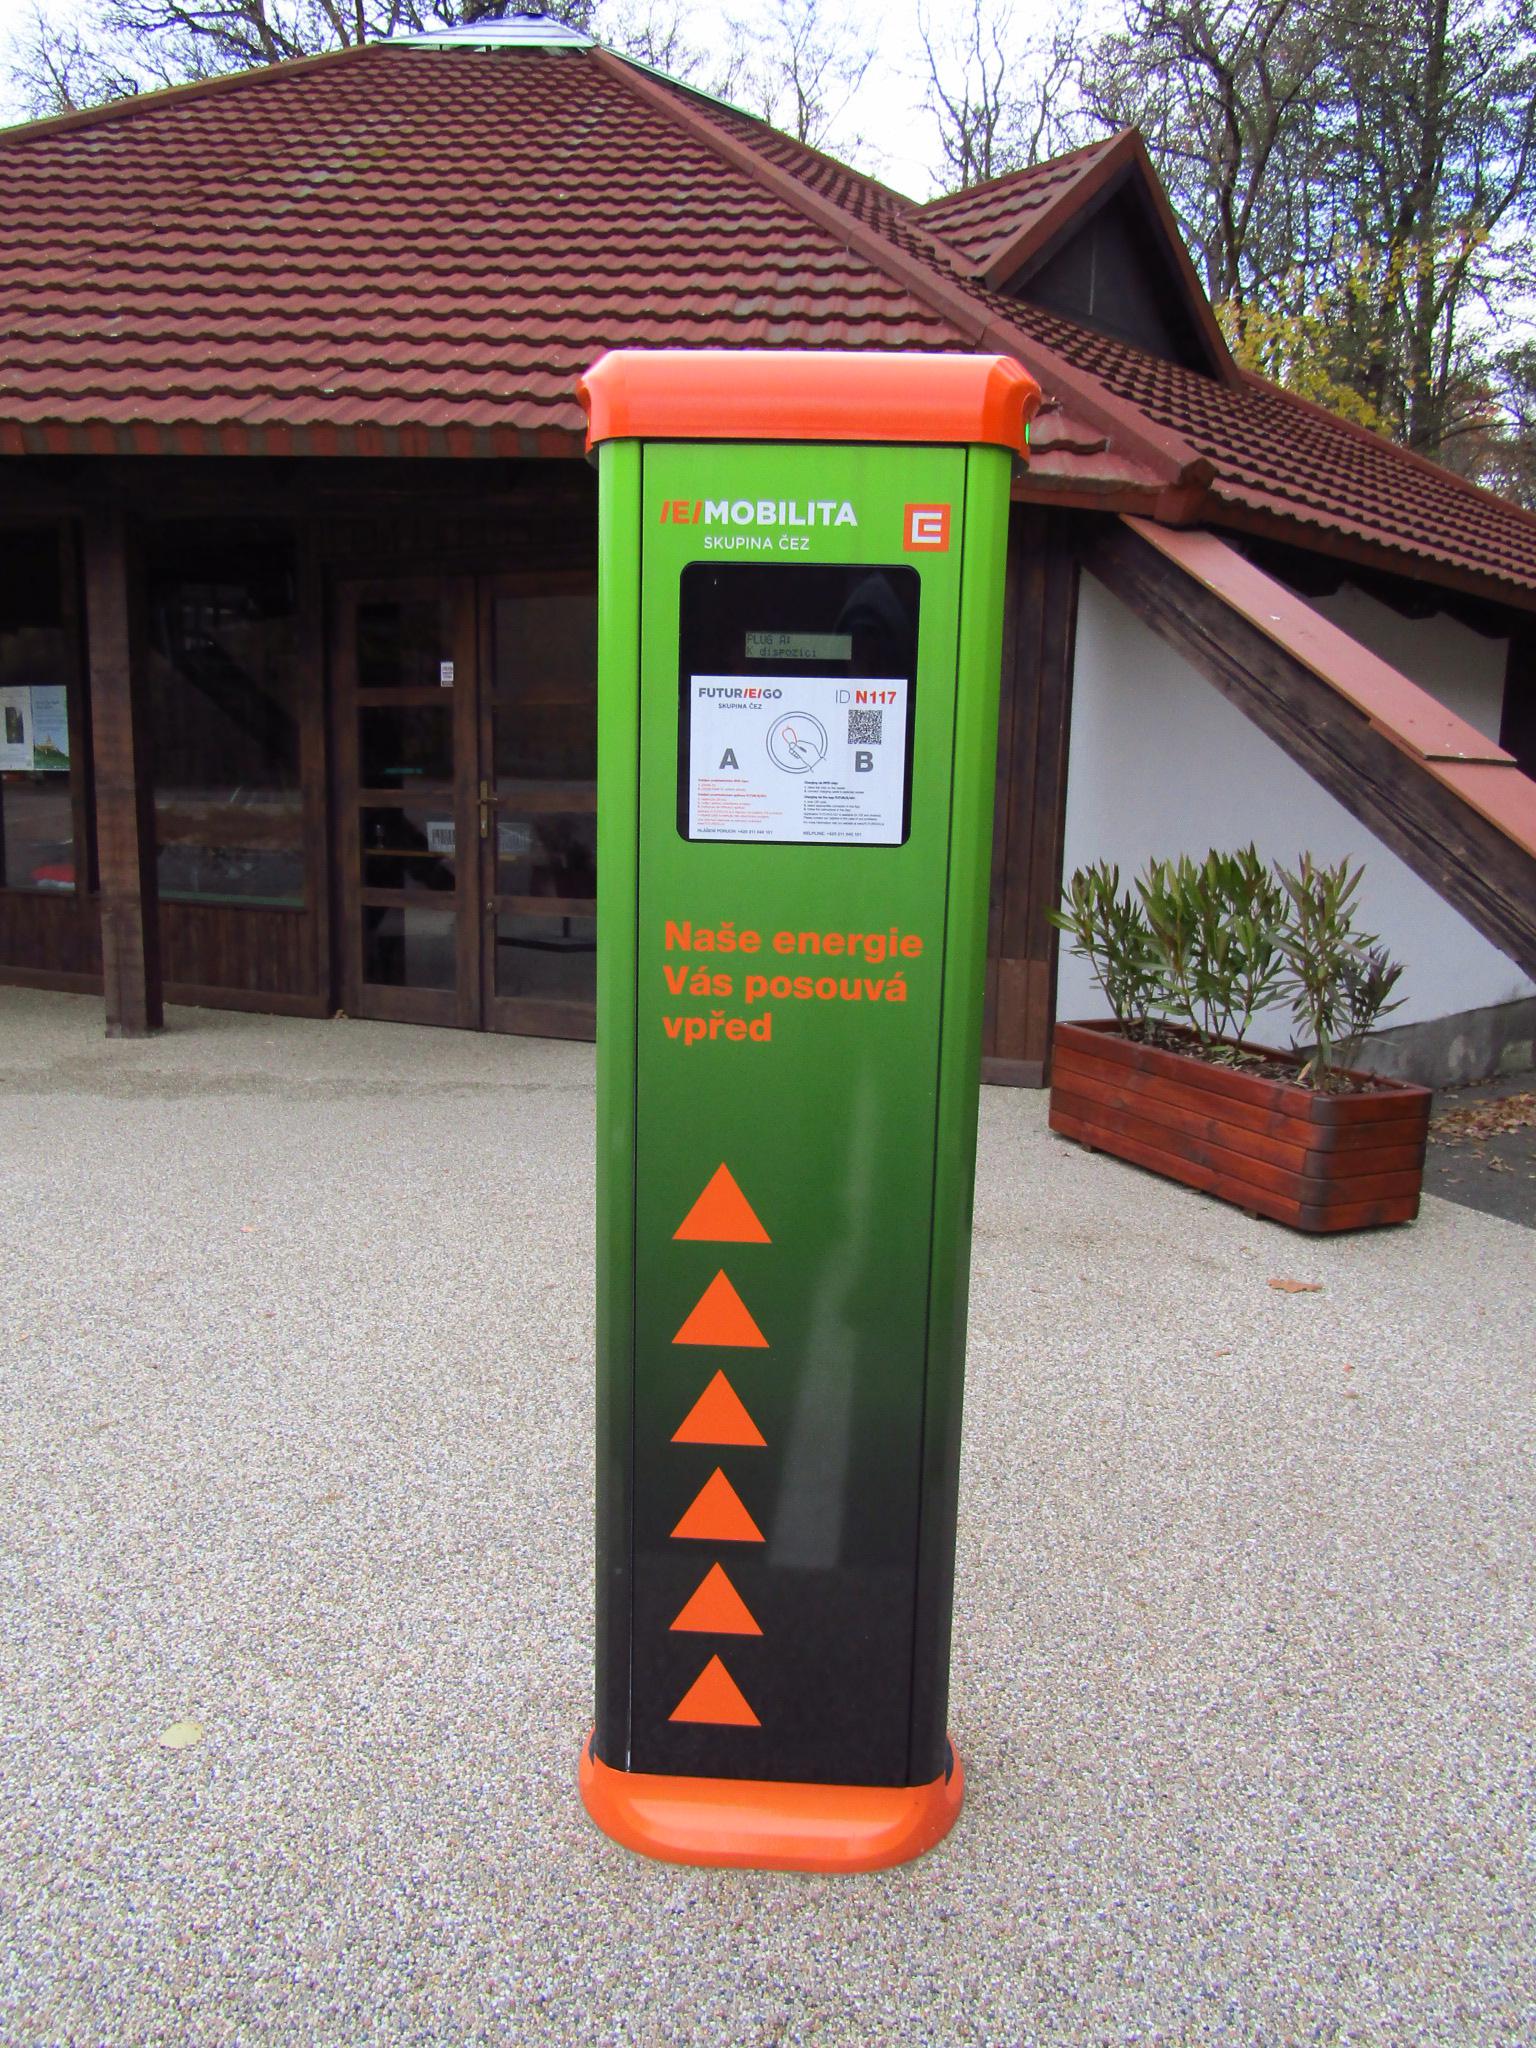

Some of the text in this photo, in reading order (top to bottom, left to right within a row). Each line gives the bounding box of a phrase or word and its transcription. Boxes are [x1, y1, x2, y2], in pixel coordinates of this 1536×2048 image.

[703, 534, 810, 550] SKUPINA ČEZ
[746, 634, 773, 645] PLUG
[698, 687, 783, 699] FUTUR/E/GO
[835, 689, 897, 705] ID N117
[748, 702, 763, 710] ČEZ
[719, 748, 739, 770] A
[855, 751, 874, 773] B
[665, 920, 923, 964] Naše energie
[663, 964, 907, 1004] Vás posouvá
[662, 1009, 772, 1047] vpřed
